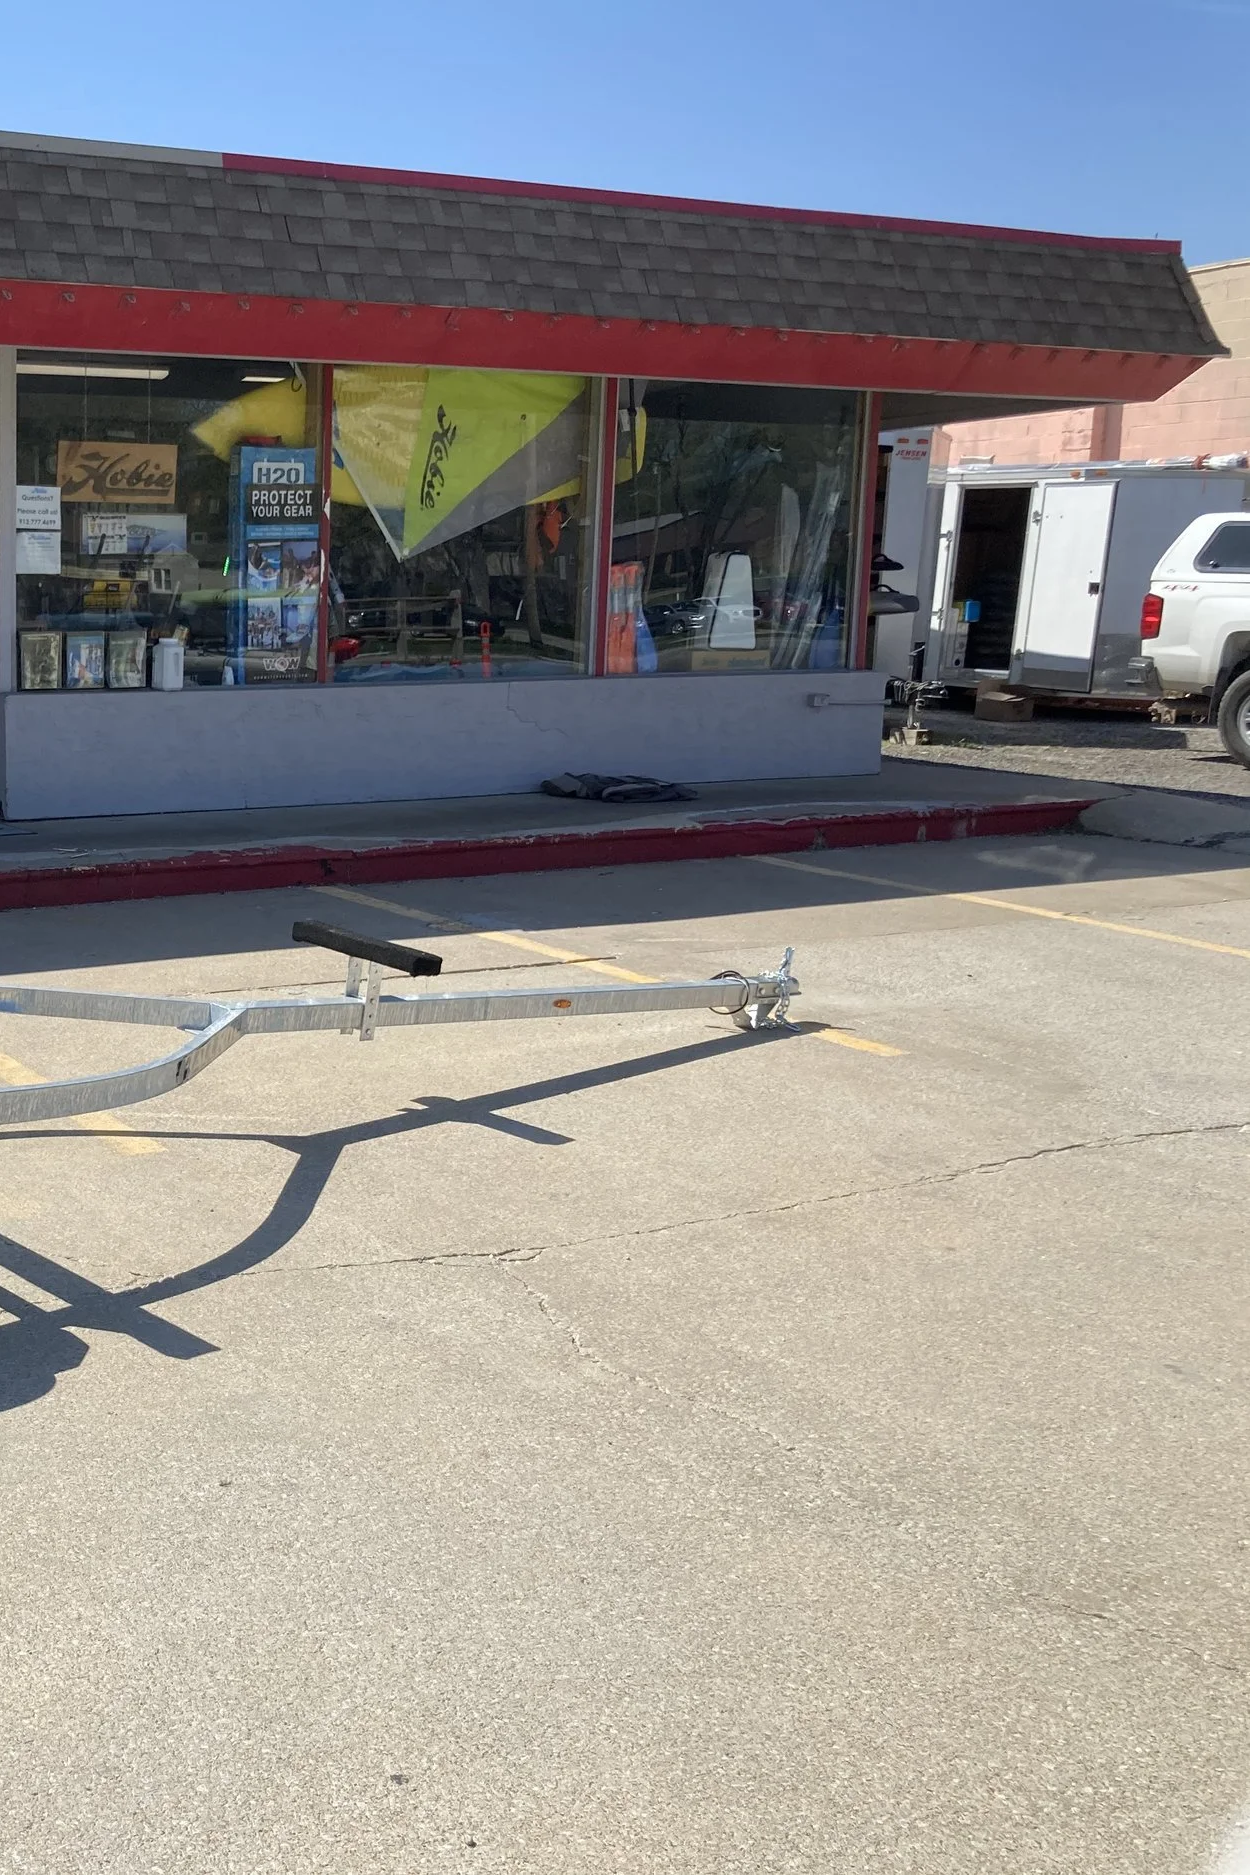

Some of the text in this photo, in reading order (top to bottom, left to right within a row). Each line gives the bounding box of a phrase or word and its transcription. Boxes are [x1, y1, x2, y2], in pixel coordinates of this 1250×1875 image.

[420, 404, 457, 511] Hobie
[61, 451, 175, 501] Hobie
[21, 494, 54, 502] Questions?
[251, 490, 313, 505] PROTECT
[17, 507, 36, 515] Please
[251, 505, 313, 517] YOUR GEAR
